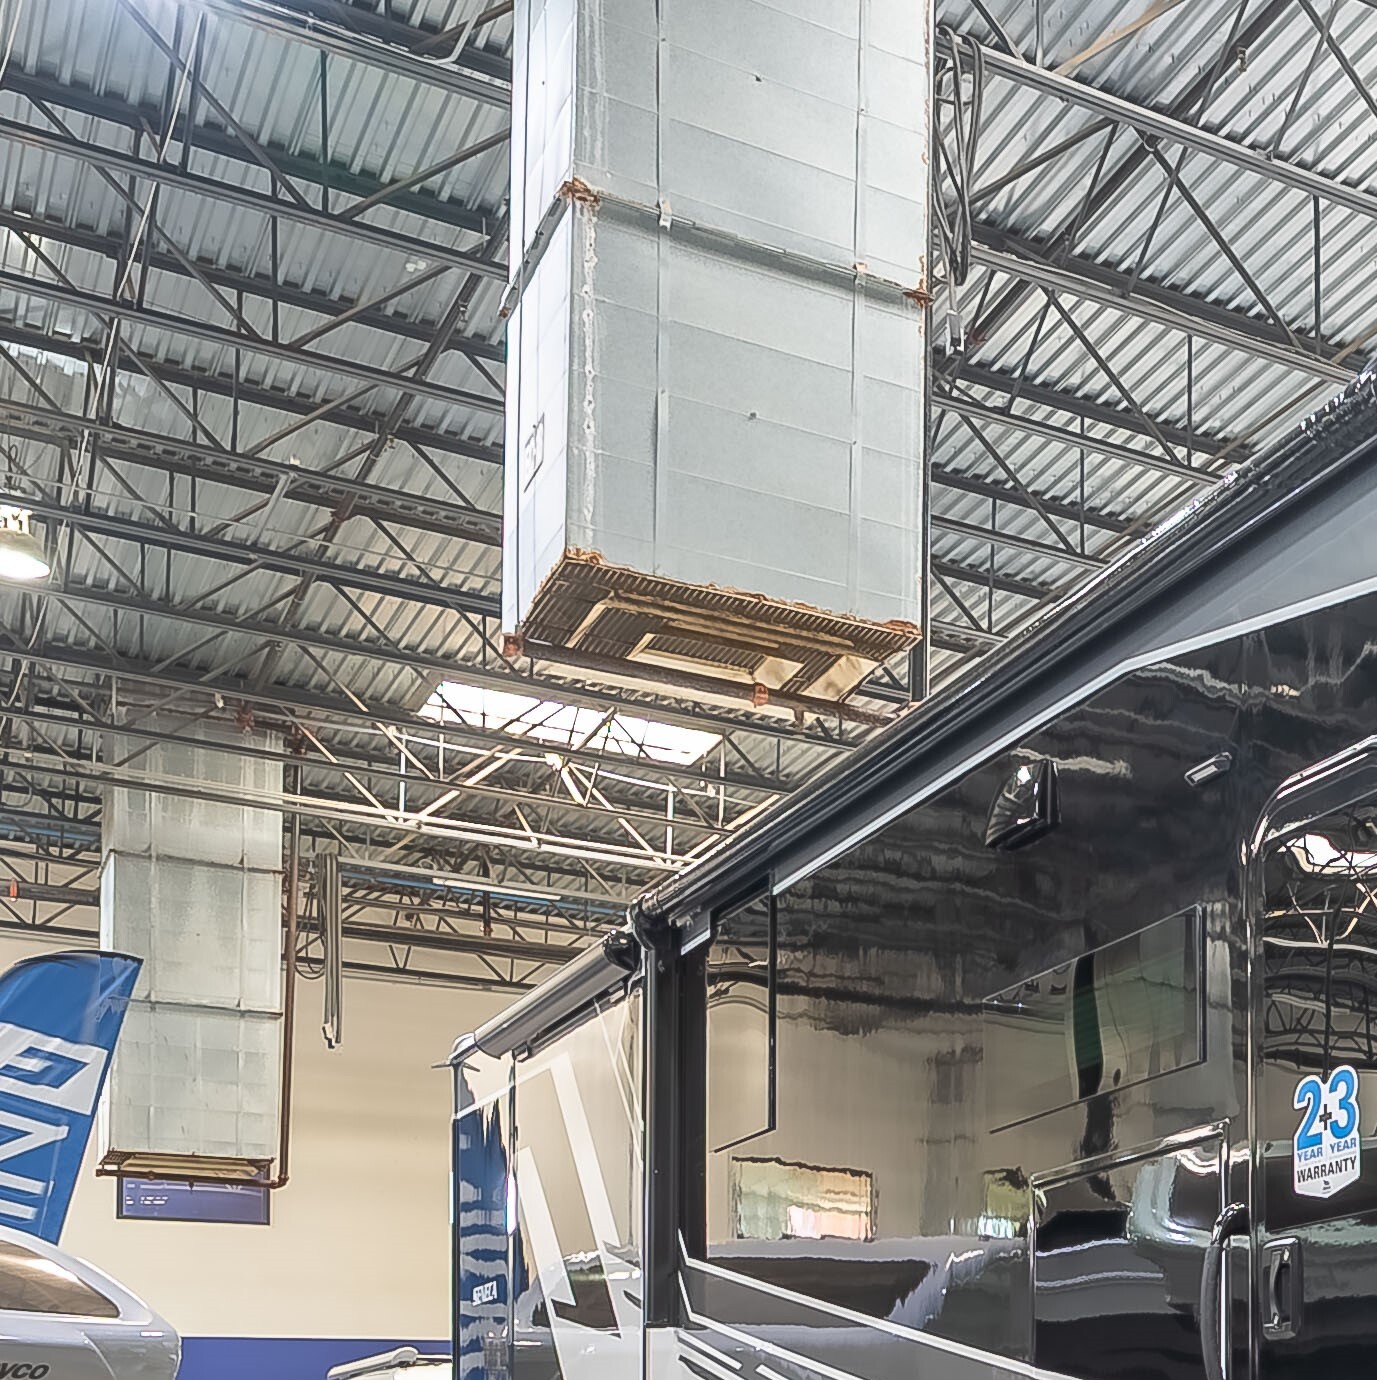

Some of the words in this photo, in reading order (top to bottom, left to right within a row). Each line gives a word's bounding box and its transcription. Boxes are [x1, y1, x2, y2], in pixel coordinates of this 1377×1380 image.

[1297, 1146, 1324, 1163] YEAR
[1330, 1137, 1357, 1154] YEAR
[1297, 1155, 1357, 1184] WARRANTY
[0, 1362, 50, 1380] yco
